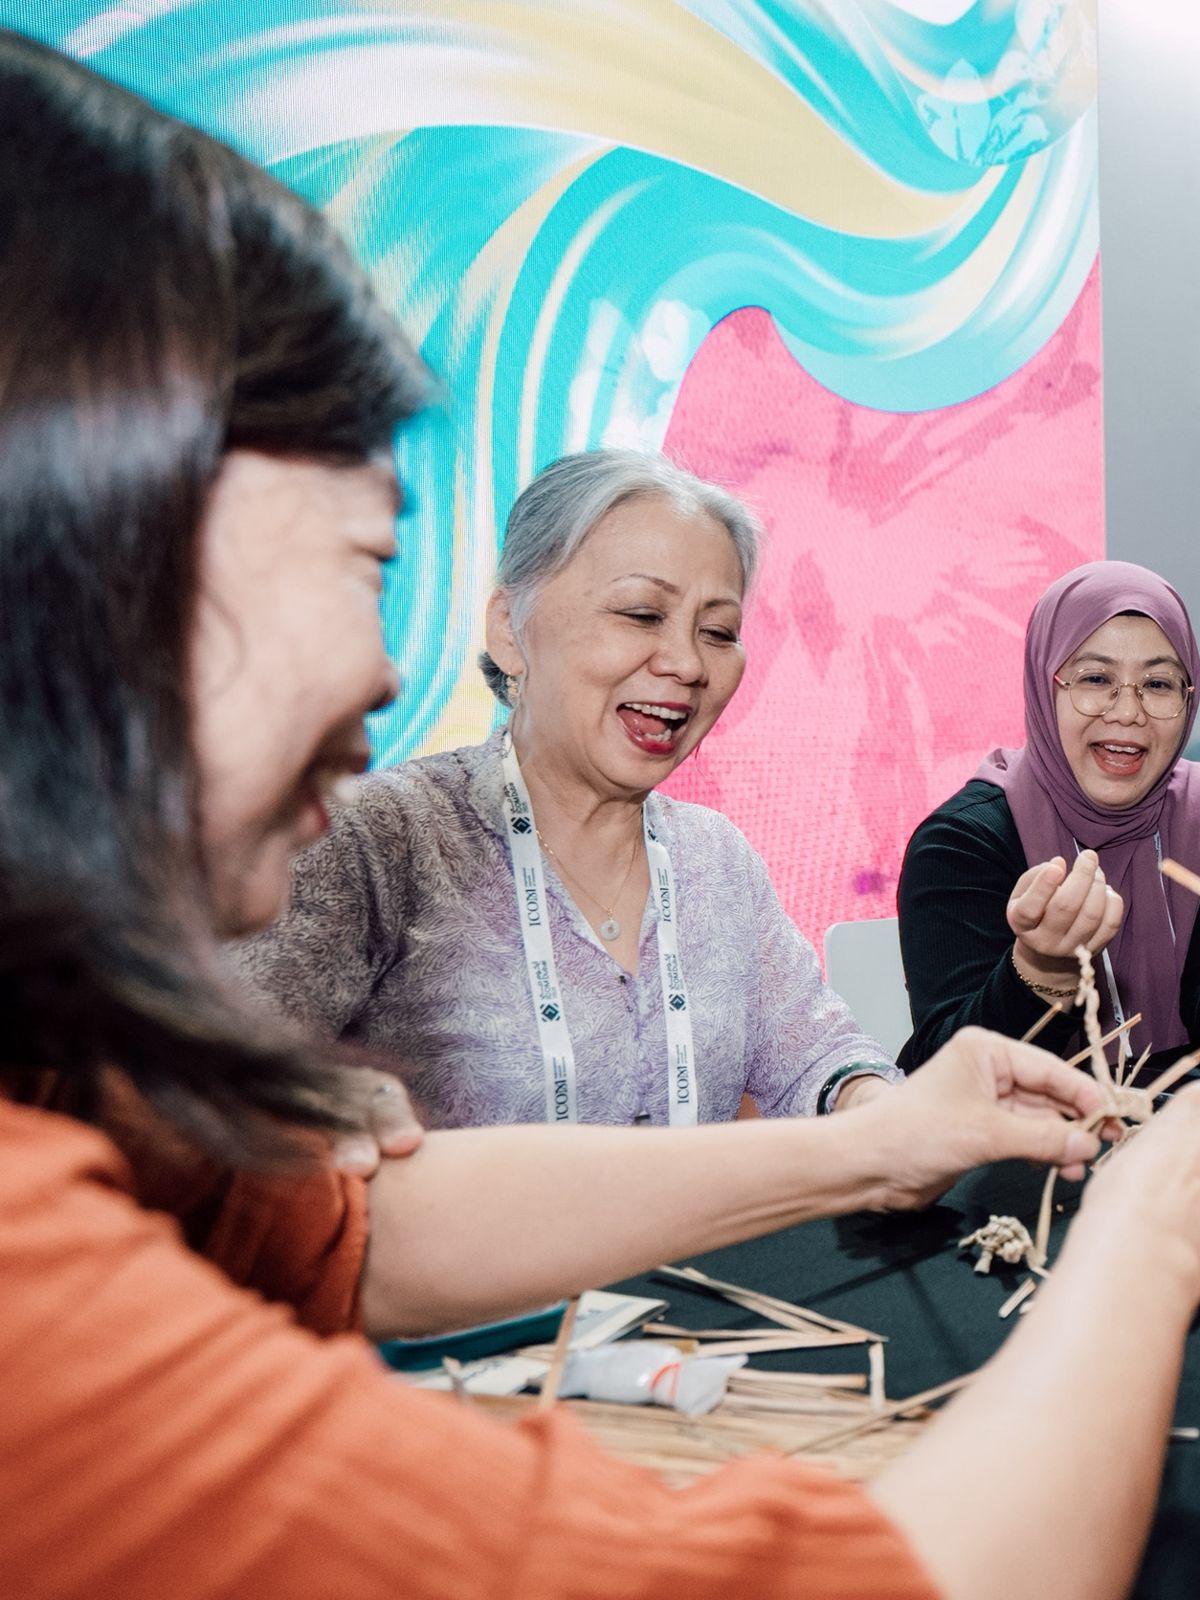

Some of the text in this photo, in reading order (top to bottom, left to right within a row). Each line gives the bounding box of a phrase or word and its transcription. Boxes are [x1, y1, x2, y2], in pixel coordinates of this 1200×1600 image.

[525, 889, 541, 926] ICOM
[660, 887, 671, 922] ICOM
[554, 1079, 569, 1121] ICOM
[677, 1066, 689, 1104] ICOM
